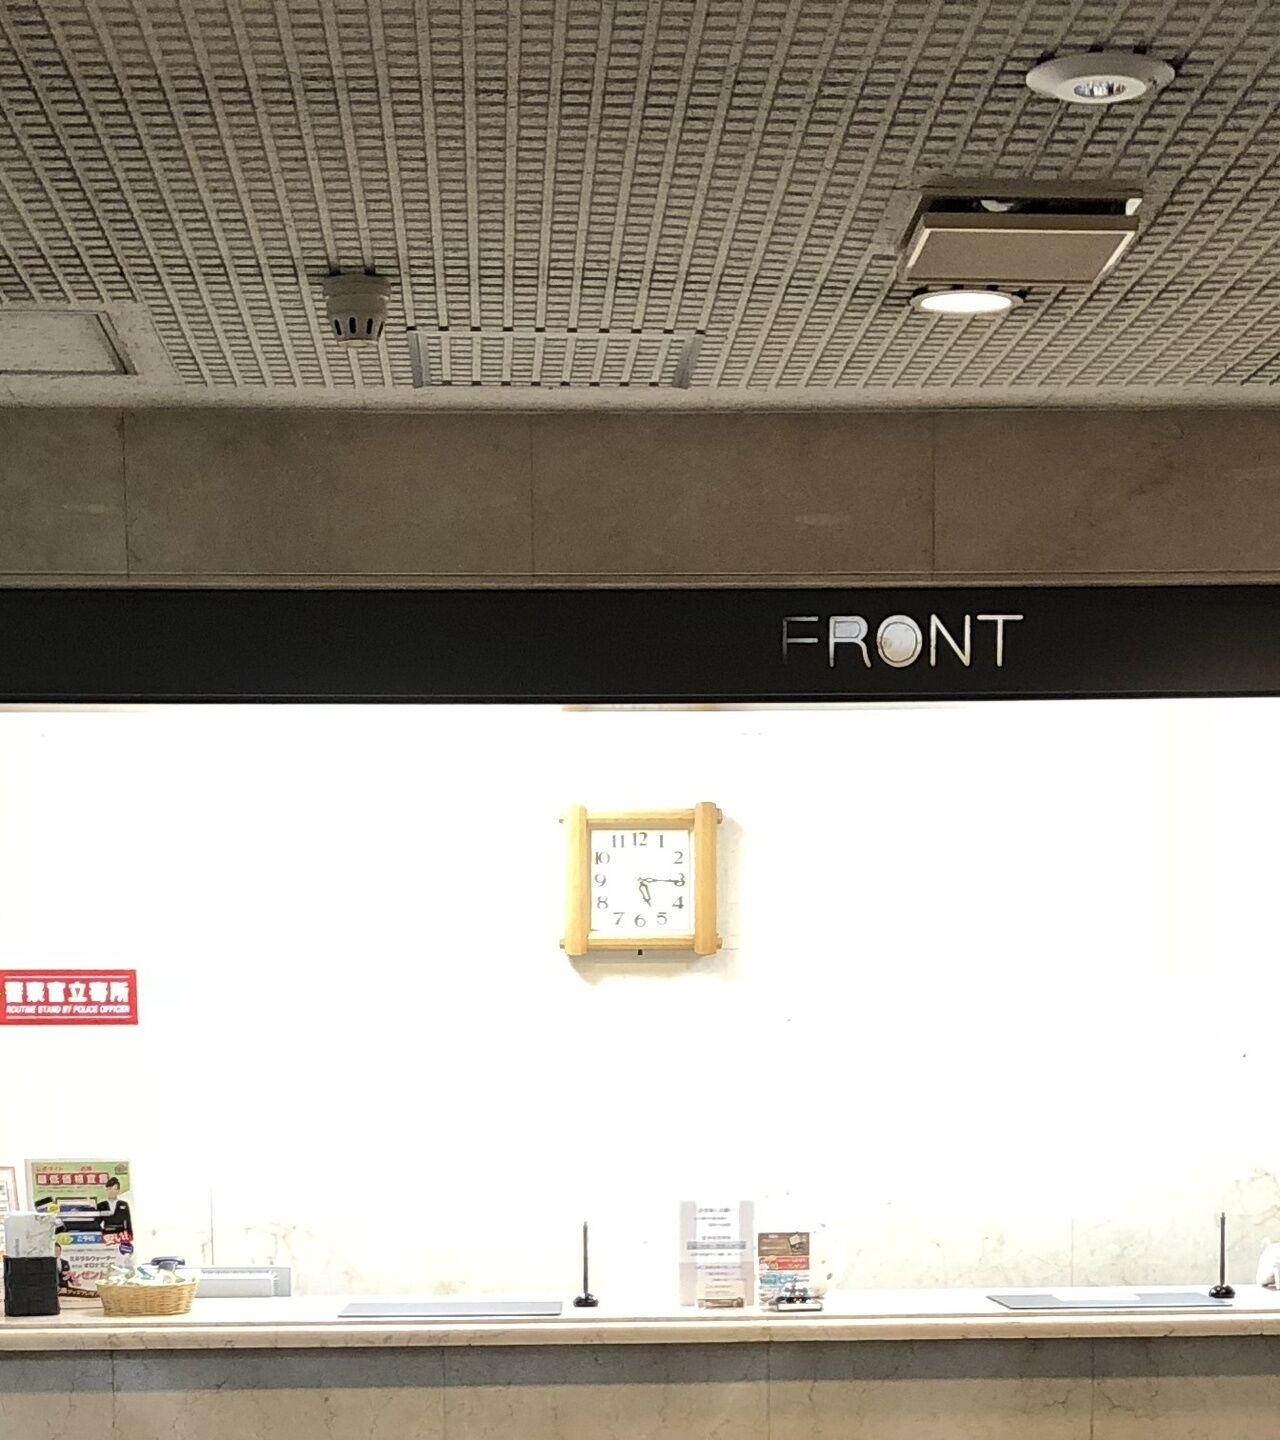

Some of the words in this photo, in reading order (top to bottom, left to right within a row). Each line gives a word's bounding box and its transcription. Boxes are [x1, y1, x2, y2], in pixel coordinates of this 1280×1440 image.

[782, 613, 1024, 668] FRONT
[612, 835, 624, 848] 11
[633, 832, 647, 846] 12
[659, 835, 664, 848] 1
[595, 851, 610, 864] 10
[673, 851, 683, 864] 2
[594, 873, 606, 887] 9
[674, 873, 685, 887] 3
[597, 896, 608, 909] 8
[672, 896, 684, 909] 4
[613, 912, 625, 925] 7
[634, 914, 646, 927] 6
[657, 912, 668, 925] 5
